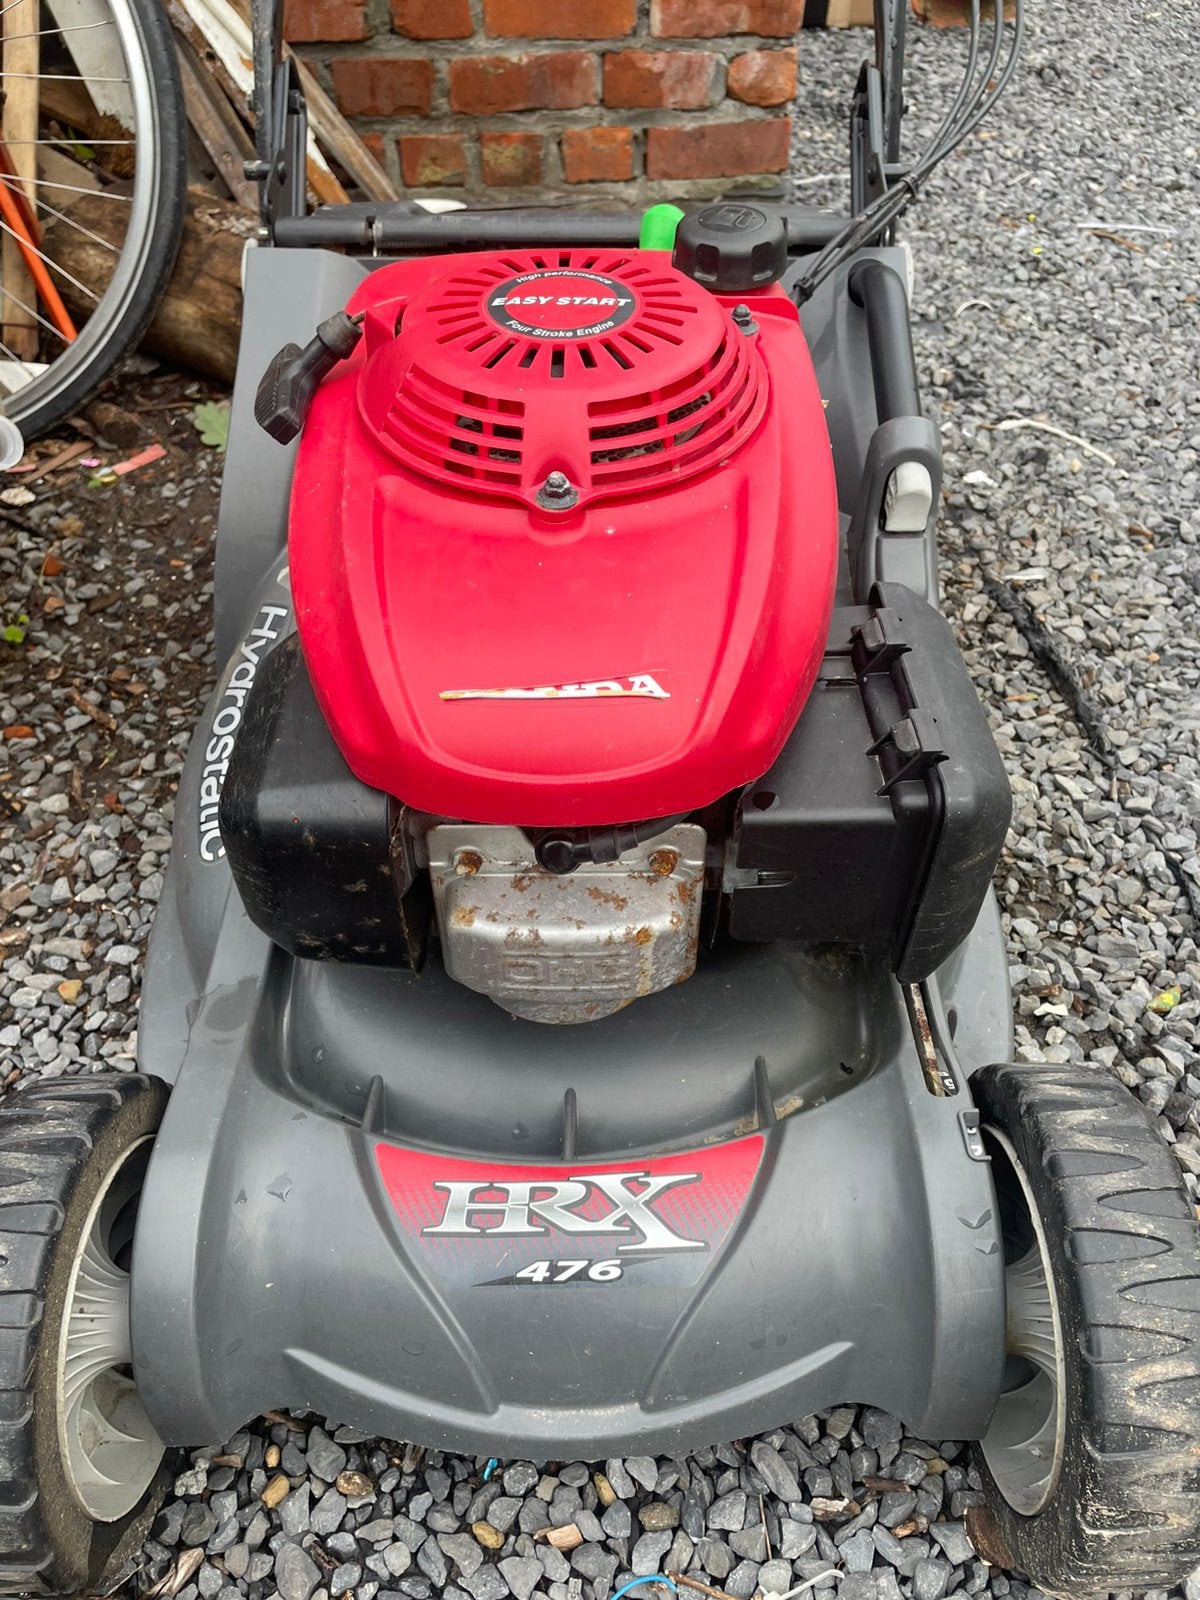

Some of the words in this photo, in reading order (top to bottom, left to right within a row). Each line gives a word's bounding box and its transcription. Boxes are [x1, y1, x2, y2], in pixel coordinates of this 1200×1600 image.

[515, 272, 542, 284] High
[544, 270, 613, 284] performance
[491, 296, 554, 307] EASY
[556, 296, 632, 307] START
[506, 320, 533, 334] Four
[532, 328, 573, 338] Stroke
[577, 321, 615, 337] Engine
[421, 1171, 708, 1252] HRX
[516, 1261, 622, 1282] 476
